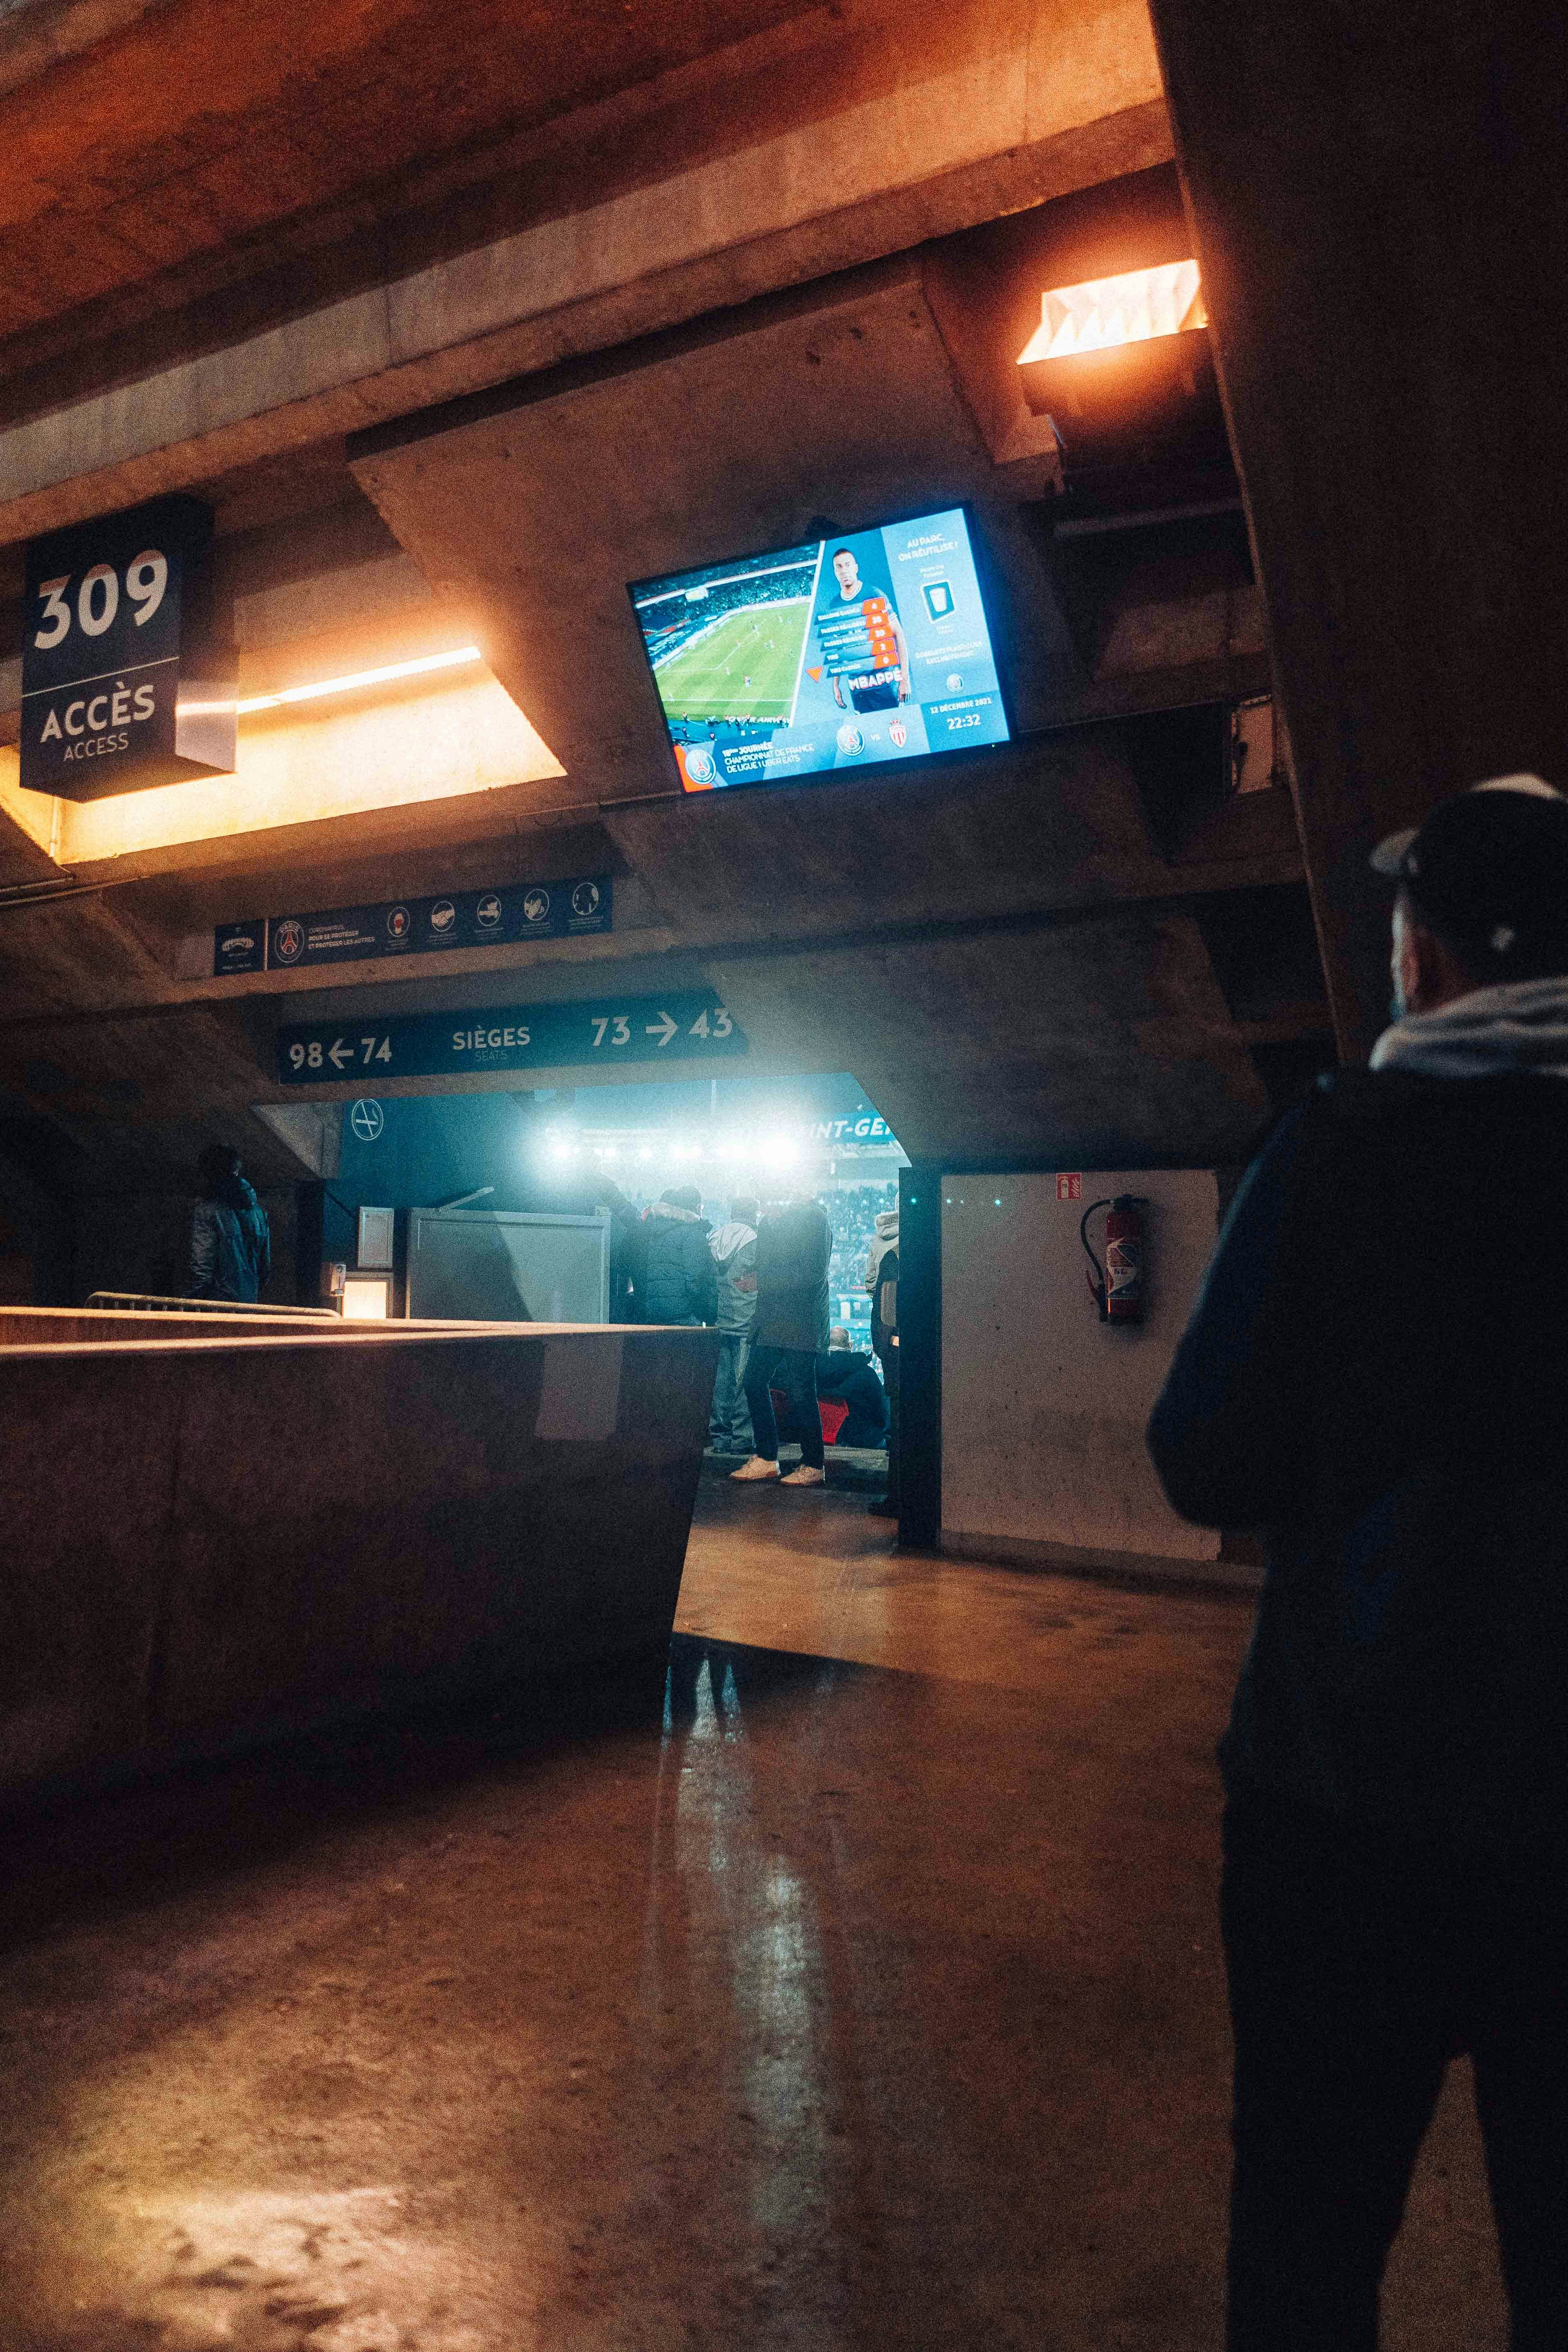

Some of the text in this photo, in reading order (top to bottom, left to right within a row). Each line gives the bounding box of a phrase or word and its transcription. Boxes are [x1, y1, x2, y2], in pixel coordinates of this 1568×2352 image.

[907, 538, 919, 549] AU
[898, 552, 911, 562] ON
[34, 550, 168, 649] 309
[880, 643, 886, 651] 2
[848, 667, 903, 690] MBAPPÉ
[40, 681, 155, 743] ACCÈS
[939, 700, 974, 713] DÉCEMBRE
[947, 713, 982, 730] 22:32
[63, 733, 129, 761] ACCESS
[724, 742, 814, 765] CHAMPIONNAT DE FRANCE
[738, 741, 773, 755] JOURNÉE
[727, 765, 738, 774] DE
[737, 762, 758, 771] LIGUE
[762, 758, 781, 768] UBER
[591, 1008, 733, 1046] 73 43
[452, 1025, 531, 1051] SIÈGES
[290, 1036, 392, 1070] 98 74
[475, 1050, 508, 1062] SEATS
